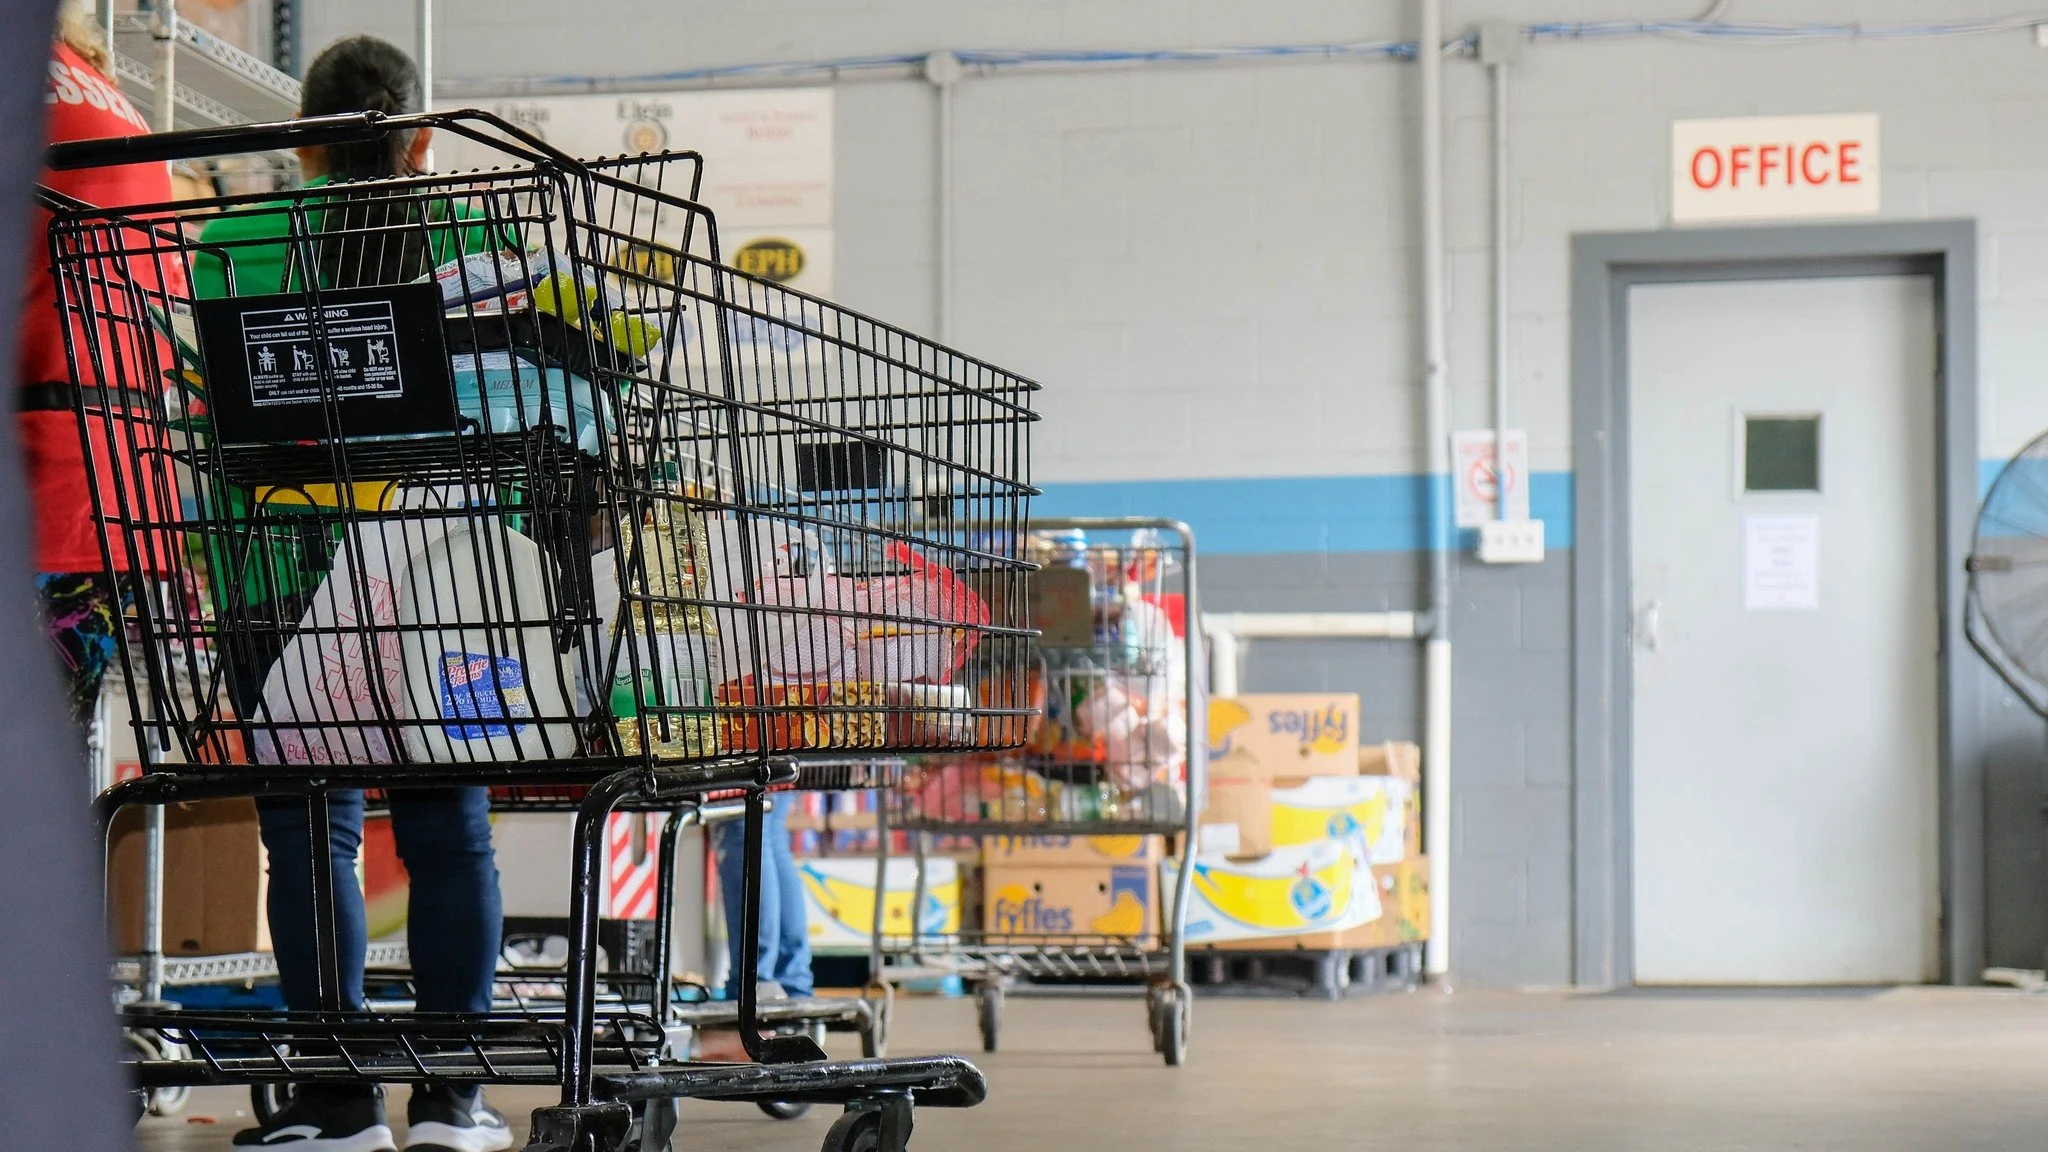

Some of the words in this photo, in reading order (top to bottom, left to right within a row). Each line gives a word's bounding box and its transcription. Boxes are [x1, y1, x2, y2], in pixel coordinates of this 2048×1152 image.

[1690, 140, 1861, 190] OFFICE
[743, 247, 801, 275] EPH
[1269, 704, 1348, 743] fyffes
[995, 897, 1073, 934] fyffes
